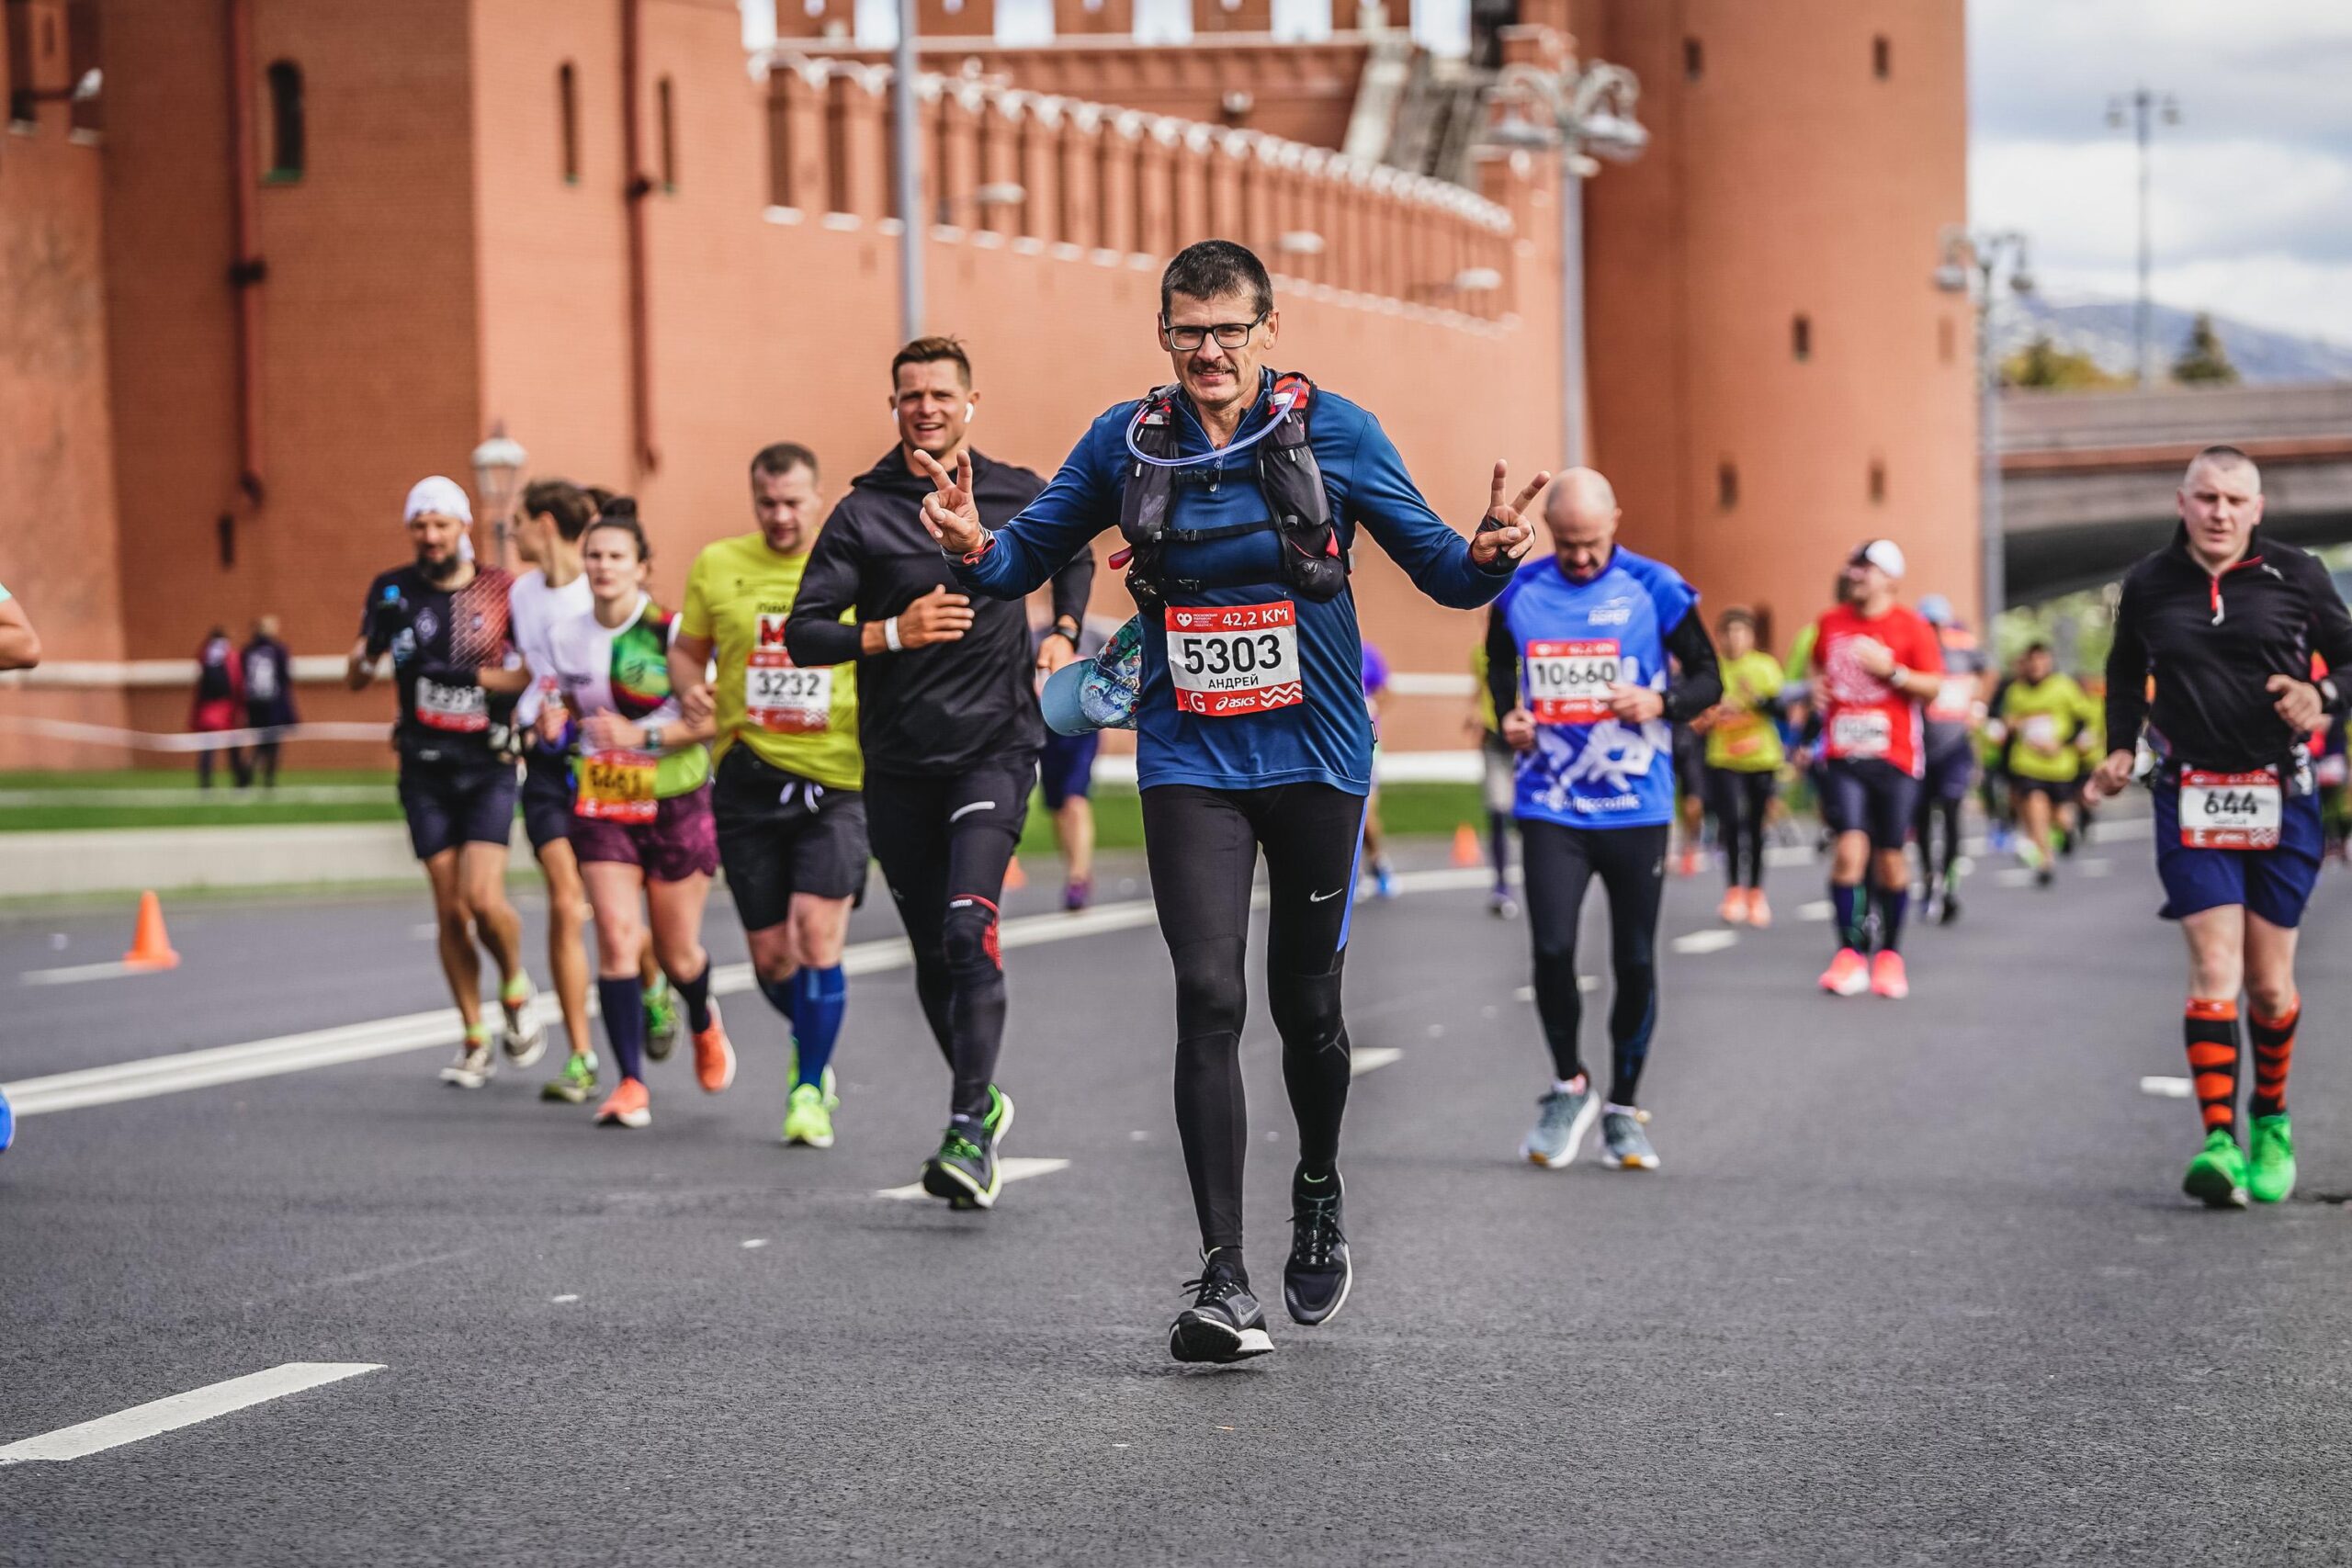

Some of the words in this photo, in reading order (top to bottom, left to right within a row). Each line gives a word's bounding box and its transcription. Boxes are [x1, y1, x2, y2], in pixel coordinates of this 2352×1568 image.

[1222, 611, 1258, 627] 42,2
[1182, 634, 1282, 675] 5303
[756, 671, 820, 696] 3232
[1208, 674, 1259, 690] АНДРЕЙ
[1534, 660, 1616, 685] 10660
[1190, 692, 1206, 713] G
[1227, 696, 1256, 708] asics
[2203, 790, 2258, 815] 644
